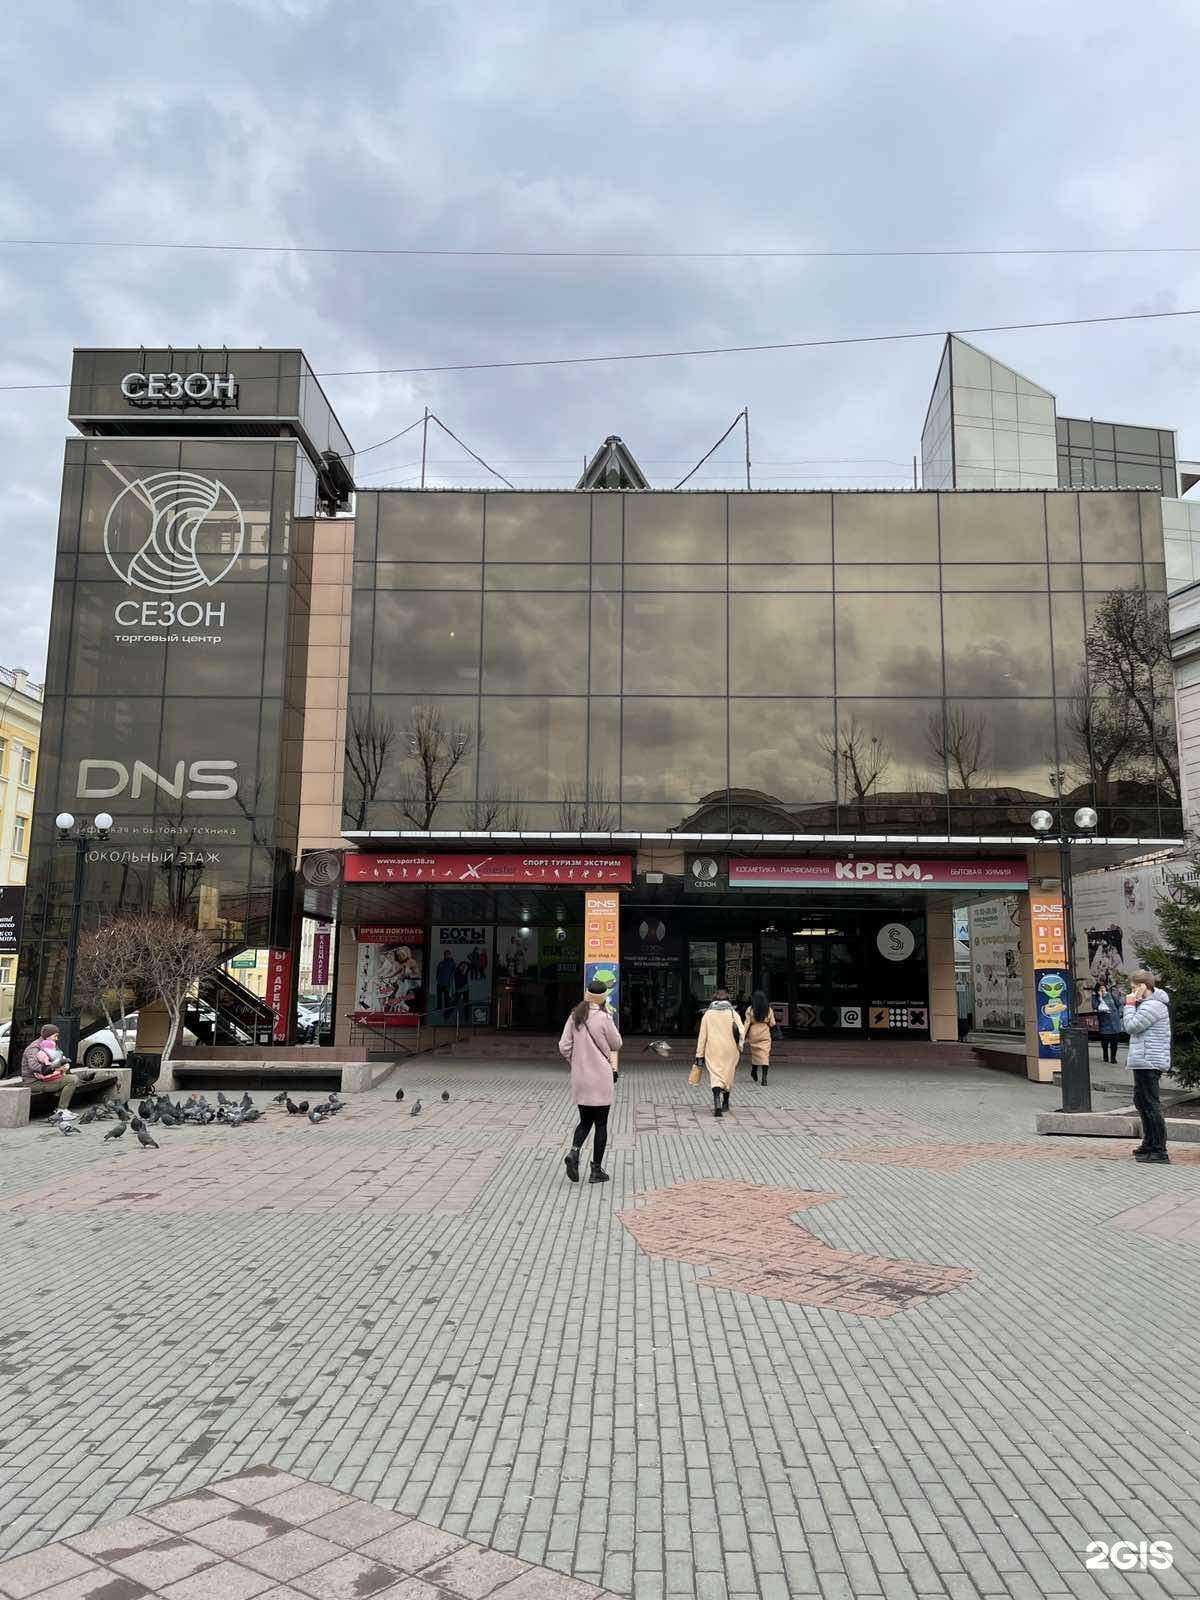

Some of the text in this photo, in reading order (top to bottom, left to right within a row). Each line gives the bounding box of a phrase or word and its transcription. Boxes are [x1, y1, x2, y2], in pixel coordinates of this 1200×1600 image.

[121, 373, 235, 400] СЕЗОН
[114, 600, 225, 627] СЕЗОН
[114, 633, 222, 644] торговый центр
[76, 759, 239, 800] DNS
[85, 848, 221, 863] ОКОЛЬНЫЙ ЭТАЖ
[522, 859, 622, 868] СПОРТ ТУРИЗМ ЭКСТРИМ
[736, 865, 777, 874] КОСМЕТИКА
[694, 881, 717, 889] СЕЗОН
[587, 899, 617, 908] DNS
[1032, 904, 1064, 913] DNS
